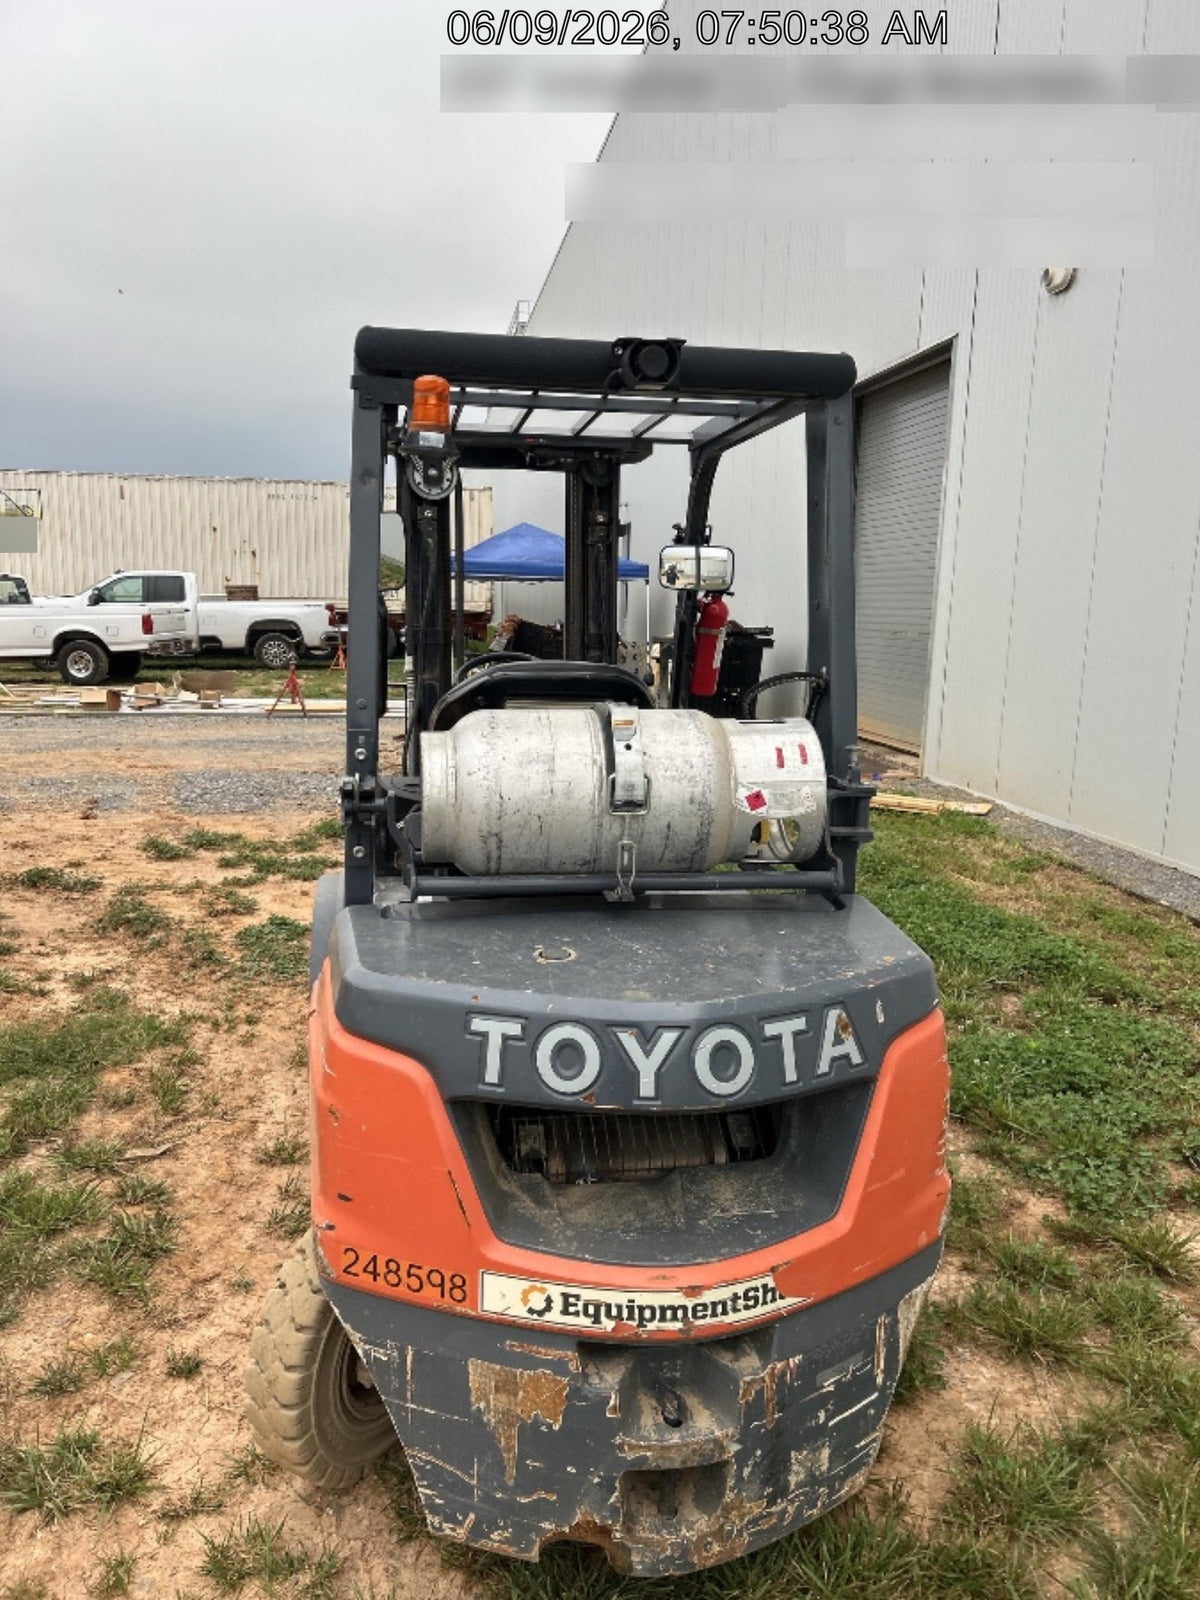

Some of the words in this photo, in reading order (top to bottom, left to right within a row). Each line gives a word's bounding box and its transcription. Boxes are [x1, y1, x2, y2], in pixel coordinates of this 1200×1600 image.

[468, 1008, 866, 1100] TOYOTA
[342, 1247, 467, 1303] 248598
[559, 1283, 786, 1328] EquipmentSh
